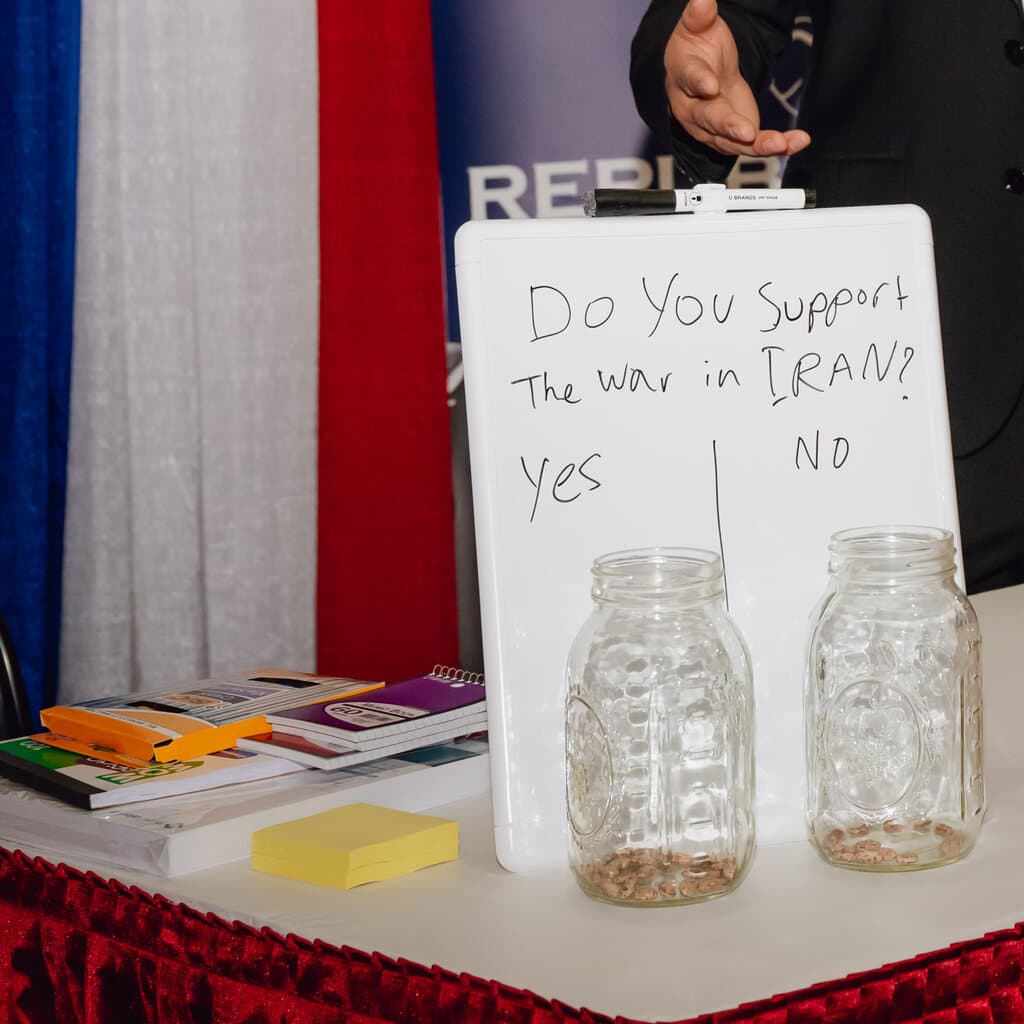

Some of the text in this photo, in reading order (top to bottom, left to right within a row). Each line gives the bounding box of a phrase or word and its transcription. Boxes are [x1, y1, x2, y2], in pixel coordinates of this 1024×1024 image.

[530, 285, 615, 343] Do
[511, 339, 916, 410] The war in IRAN?
